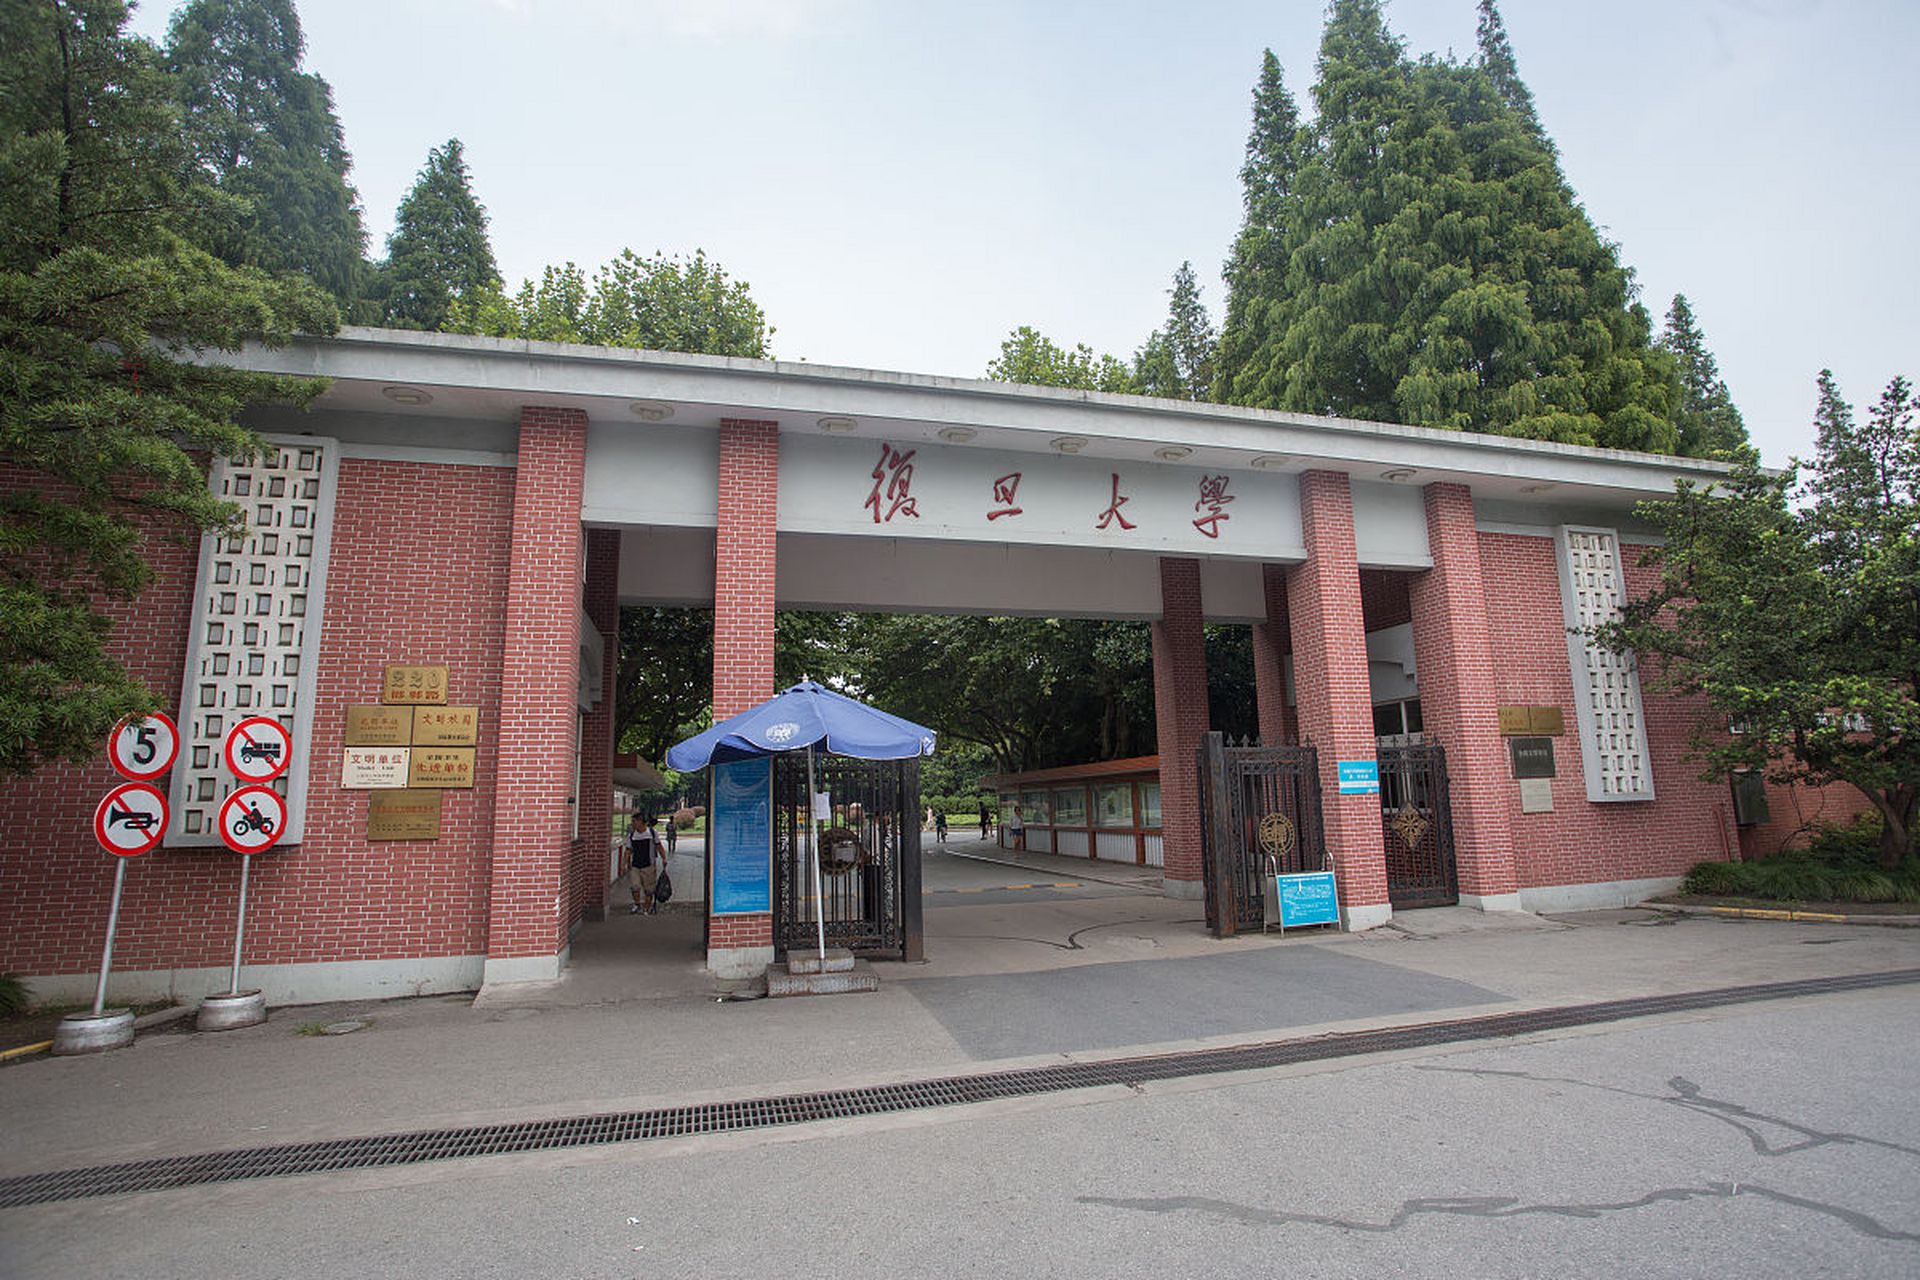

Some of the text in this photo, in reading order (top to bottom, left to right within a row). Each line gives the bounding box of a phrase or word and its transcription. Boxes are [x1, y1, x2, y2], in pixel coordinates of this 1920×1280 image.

[864, 443, 1236, 539] 復旦大學
[133, 728, 157, 765] 5
[351, 754, 402, 764] 文明单位
